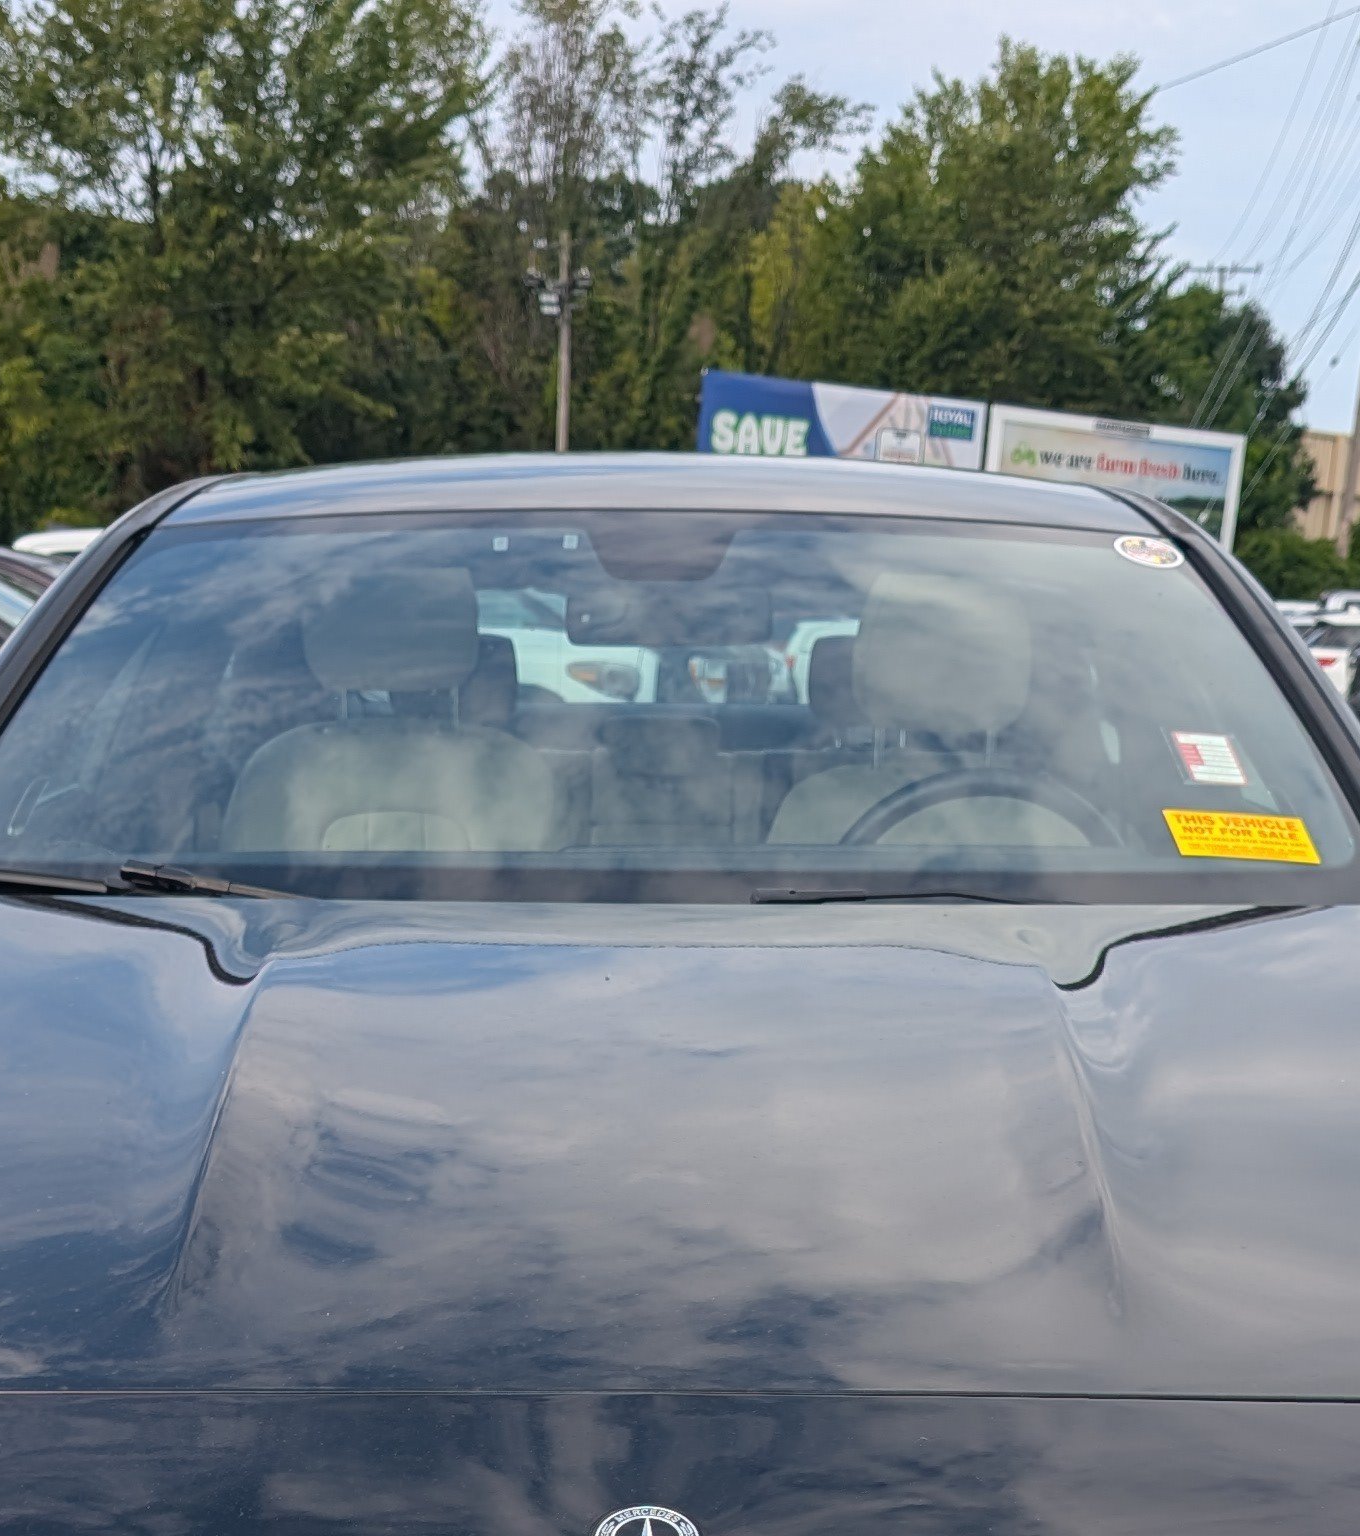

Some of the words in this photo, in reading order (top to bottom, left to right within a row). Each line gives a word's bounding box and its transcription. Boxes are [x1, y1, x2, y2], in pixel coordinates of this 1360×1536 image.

[711, 409, 810, 456] SAVE
[1174, 813, 1215, 826] THIS
[1219, 816, 1299, 832] VEHICLE
[1182, 825, 1214, 835] NOT
[1220, 827, 1252, 837] FOR
[1257, 830, 1300, 841] SALE
[614, 1508, 681, 1523] MERCEDES
